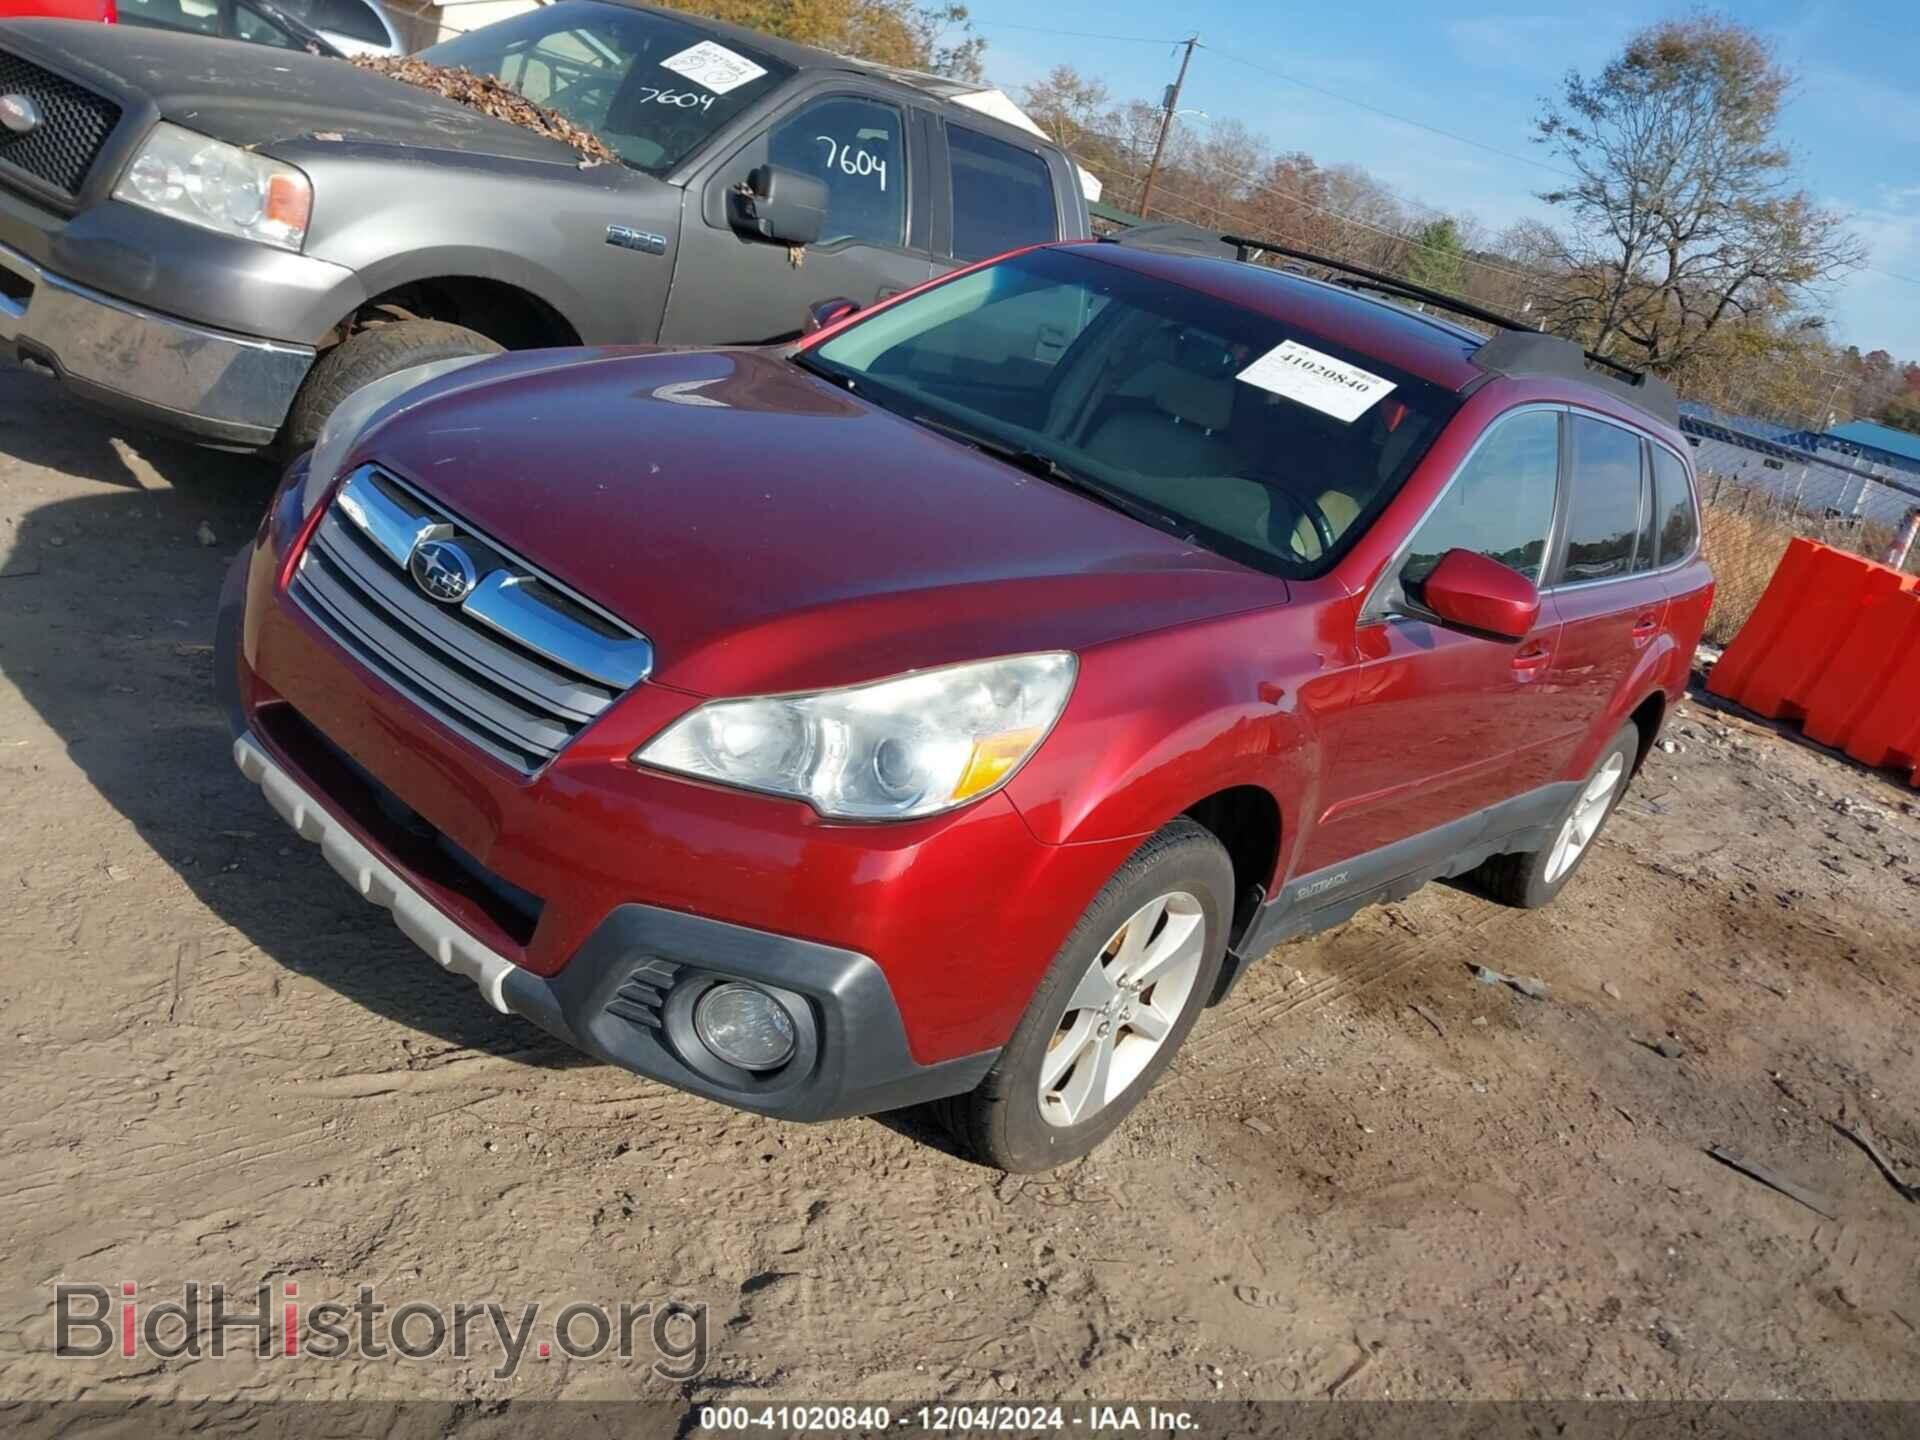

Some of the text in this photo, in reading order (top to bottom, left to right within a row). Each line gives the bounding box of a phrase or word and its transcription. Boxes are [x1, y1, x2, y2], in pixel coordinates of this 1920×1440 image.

[639, 86, 716, 111] 7604
[816, 135, 887, 192] 7604
[1280, 354, 1369, 392] 41020840
